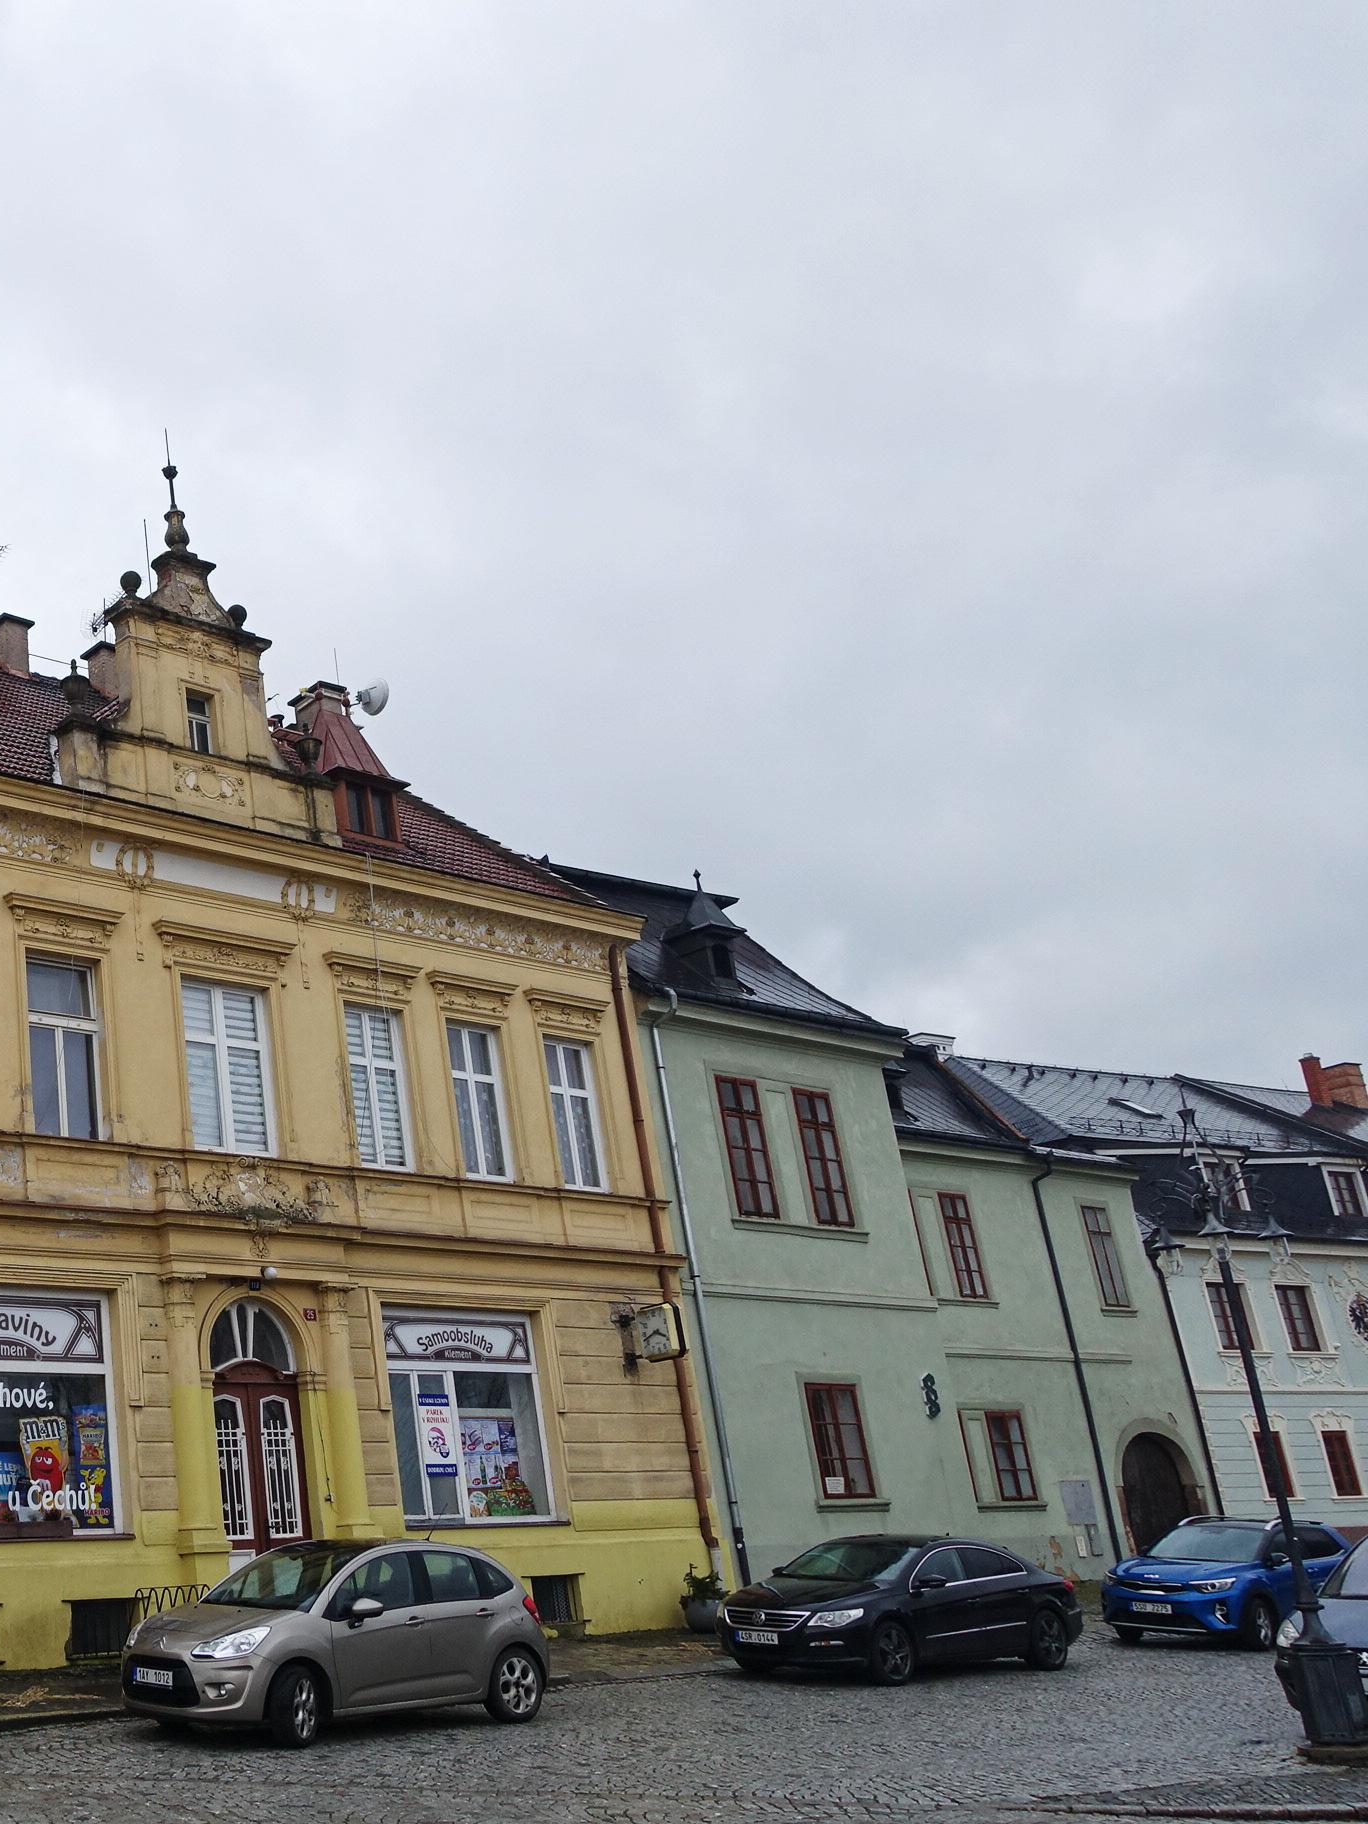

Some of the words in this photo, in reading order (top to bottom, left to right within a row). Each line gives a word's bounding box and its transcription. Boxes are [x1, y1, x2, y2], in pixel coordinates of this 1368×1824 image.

[306, 1310, 315, 1320] 25
[417, 1327, 494, 1355] Samoobsluha
[445, 1349, 471, 1359] Klement
[8, 1490, 21, 1512] u
[27, 1480, 97, 1511] Čechů!
[740, 1631, 753, 1641] 4SR
[756, 1633, 775, 1643] 0144
[138, 1669, 150, 1681] 1AY
[153, 1671, 170, 1684] 1012
